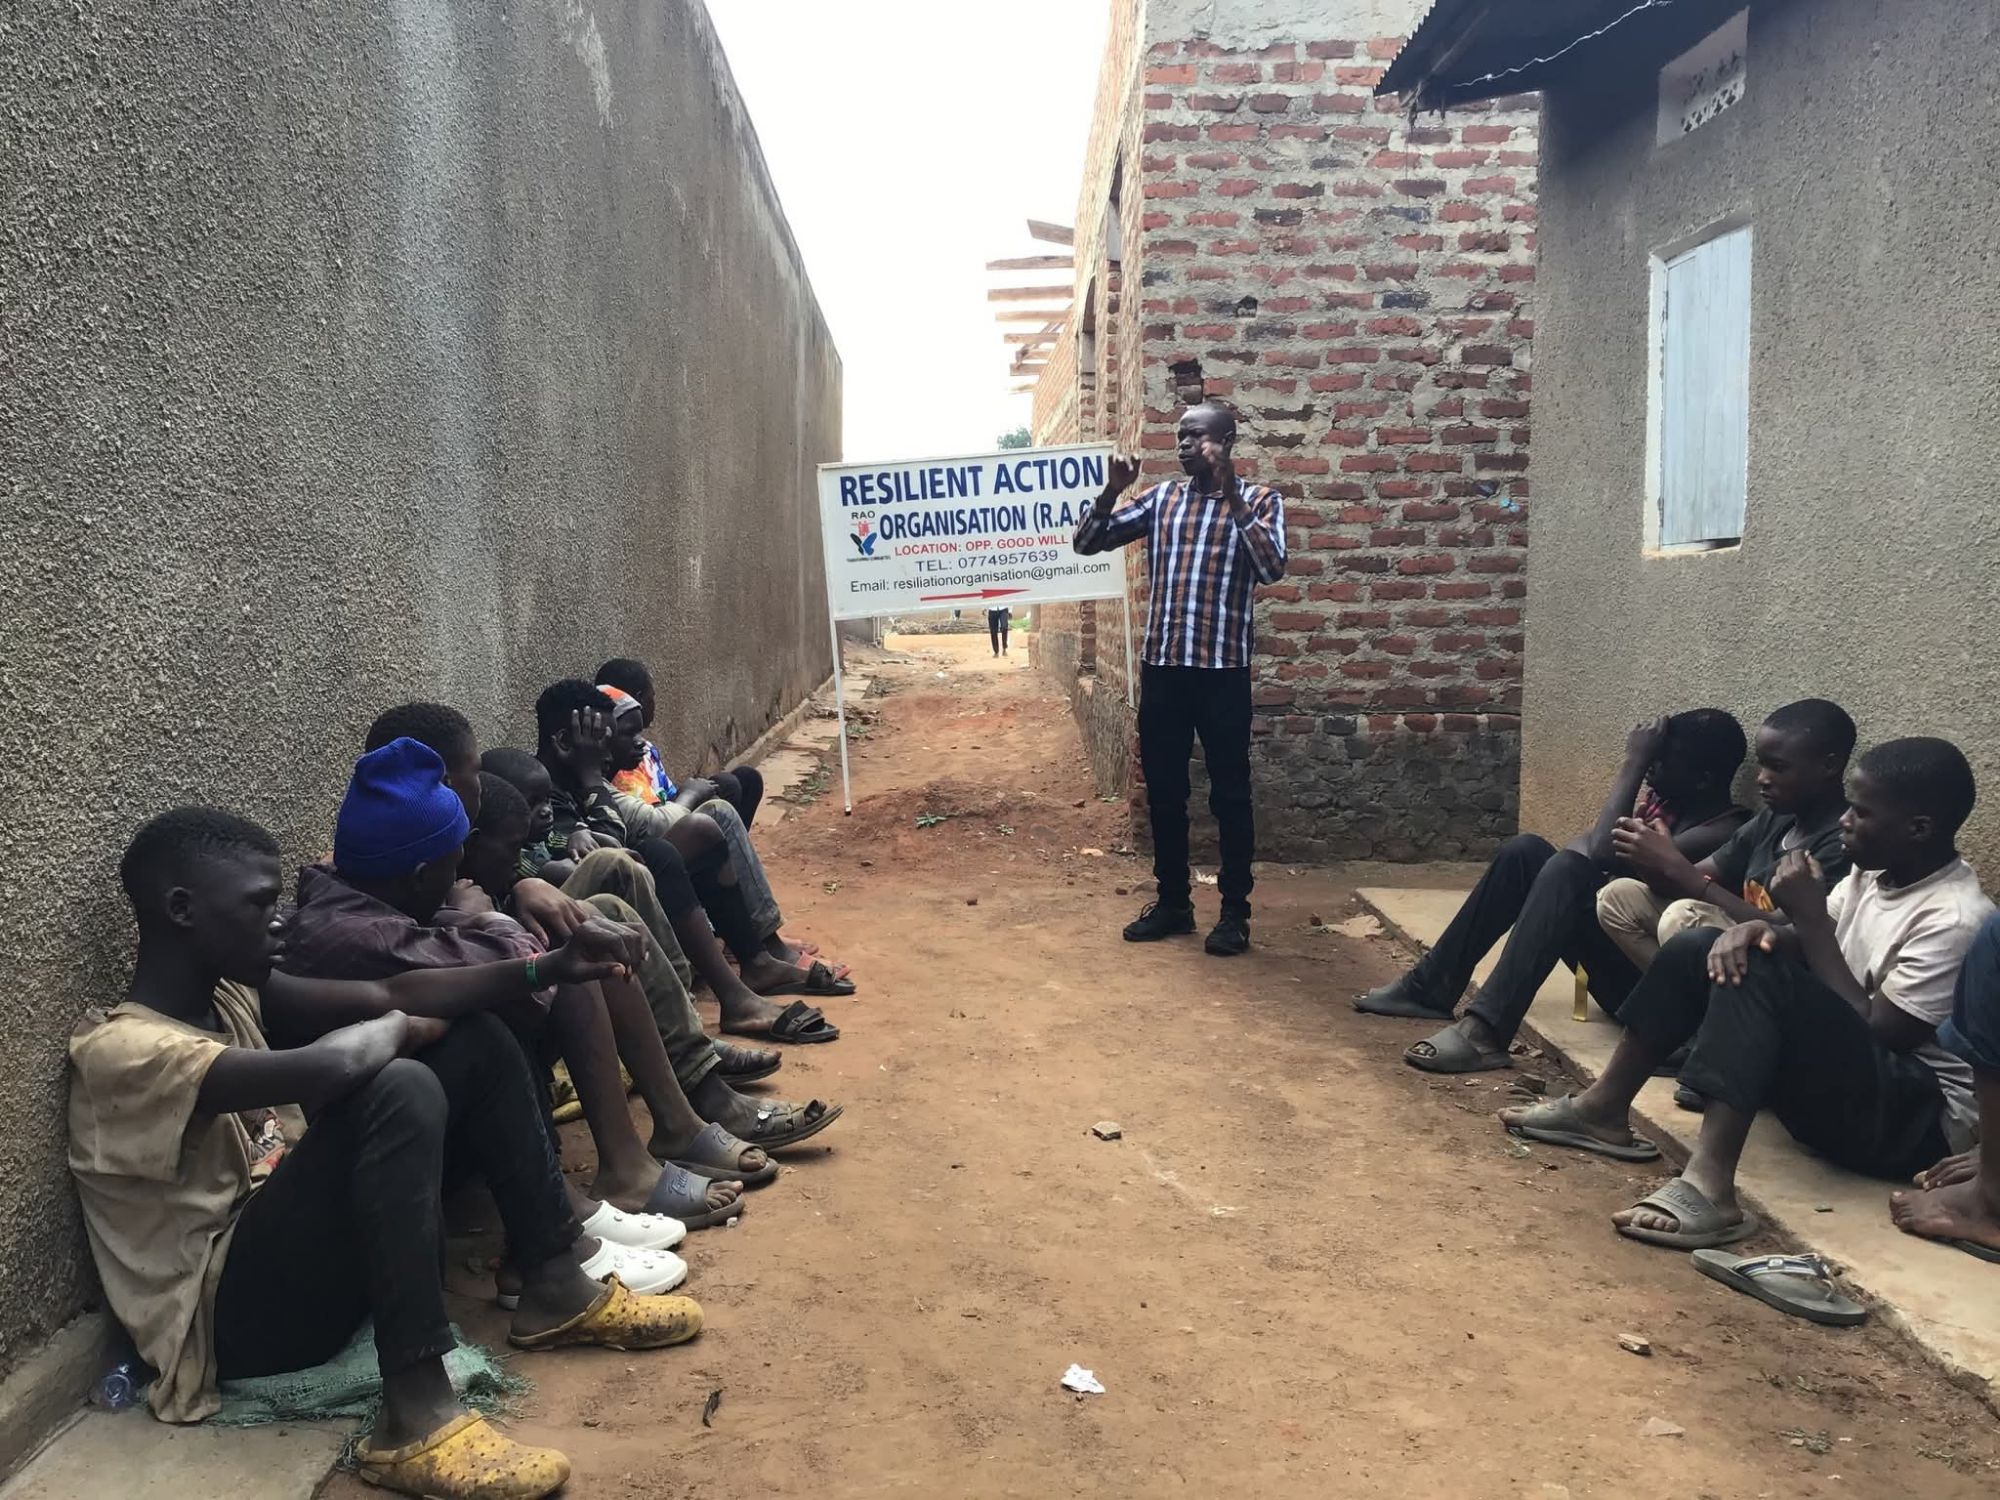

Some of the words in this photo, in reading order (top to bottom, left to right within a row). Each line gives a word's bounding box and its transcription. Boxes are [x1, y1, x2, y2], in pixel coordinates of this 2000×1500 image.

[840, 465, 983, 507] RESILIENT
[993, 455, 1104, 494] ACTION
[851, 510, 876, 520] RAO
[880, 504, 1027, 540] ORGANISATION
[895, 542, 962, 557] LOCATION:
[965, 539, 993, 552] OPP.
[996, 536, 1035, 550] GOOD
[1038, 534, 1069, 546] WILL
[915, 560, 953, 573] TEL:
[958, 549, 1059, 569] 0774957639
[850, 579, 890, 593] Email:
[893, 562, 1111, 590] resiliationorganisation@gmail.com
